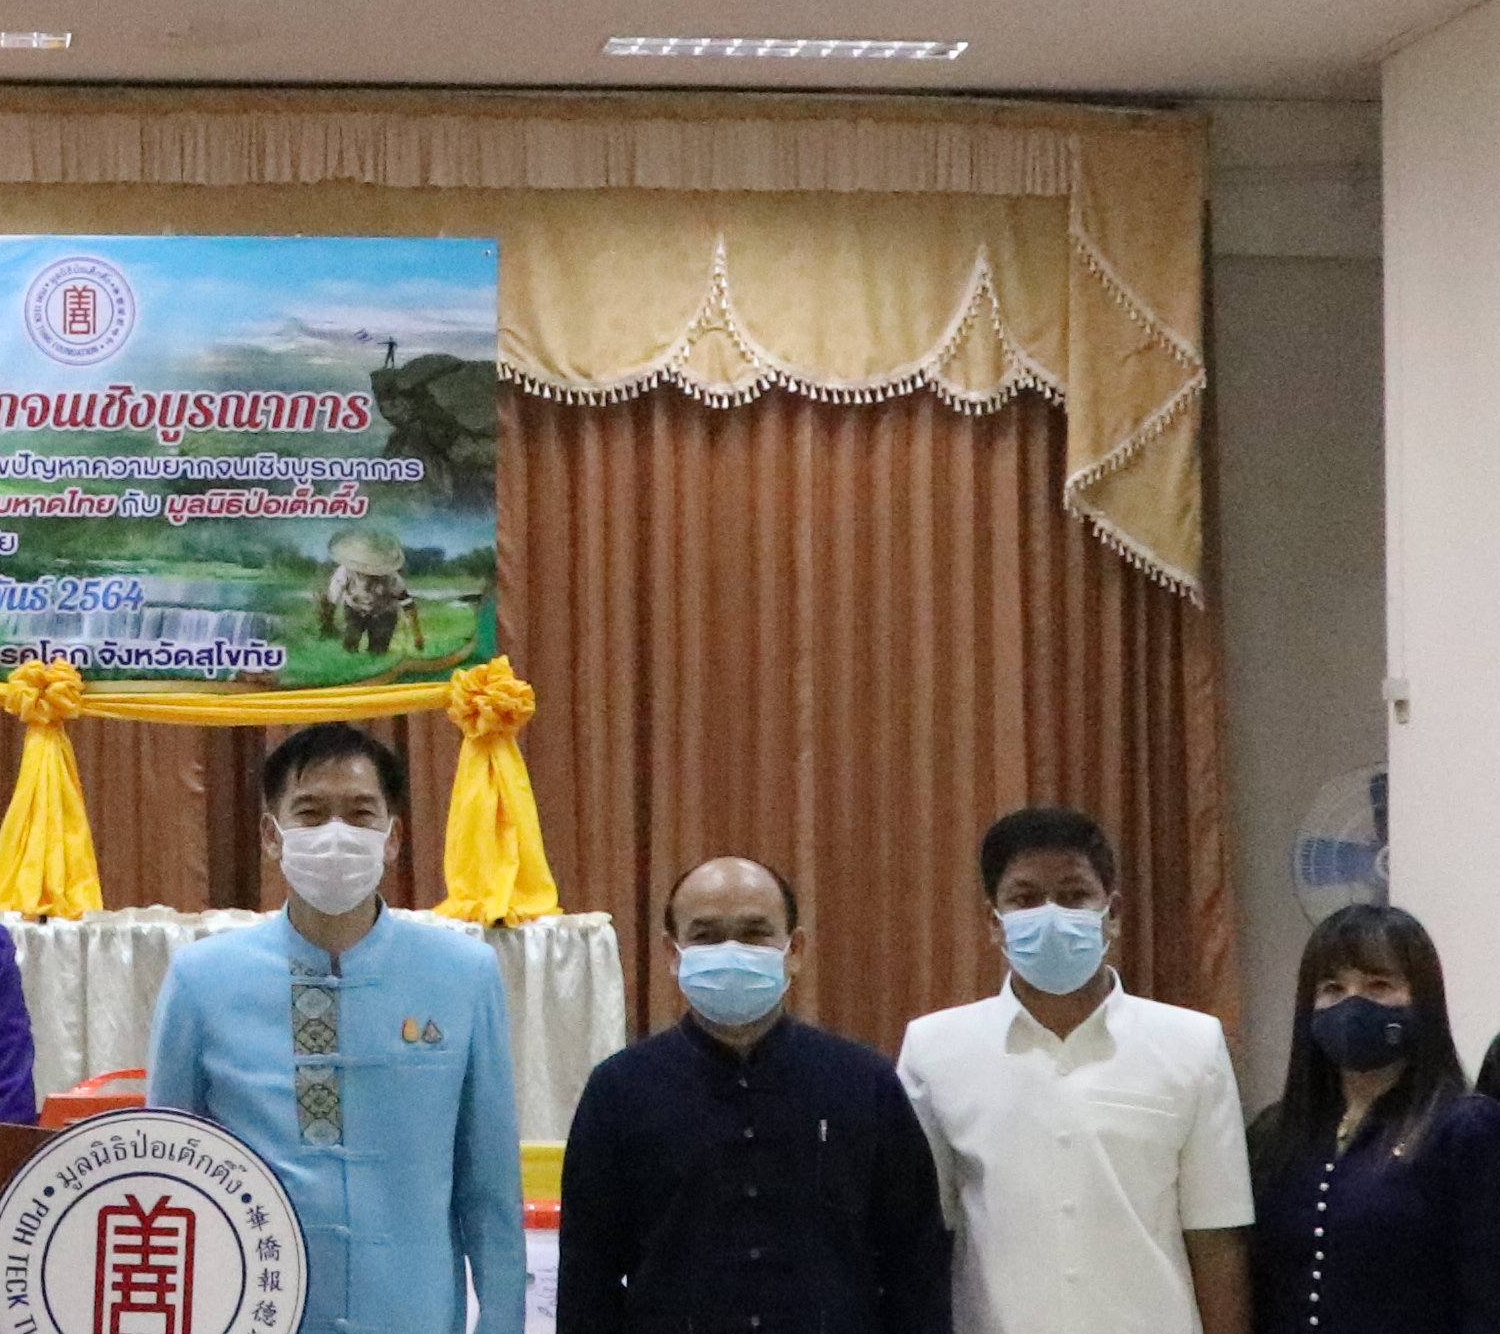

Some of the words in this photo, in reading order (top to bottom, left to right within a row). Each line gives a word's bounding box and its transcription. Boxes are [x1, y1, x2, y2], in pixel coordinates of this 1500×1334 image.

[120, 490, 158, 516] กับ
[58, 578, 144, 612] 2564
[98, 640, 285, 676] จังหวัดสุโขทัย
[13, 1197, 50, 1247] POH
[4, 1253, 31, 1310] TECK
